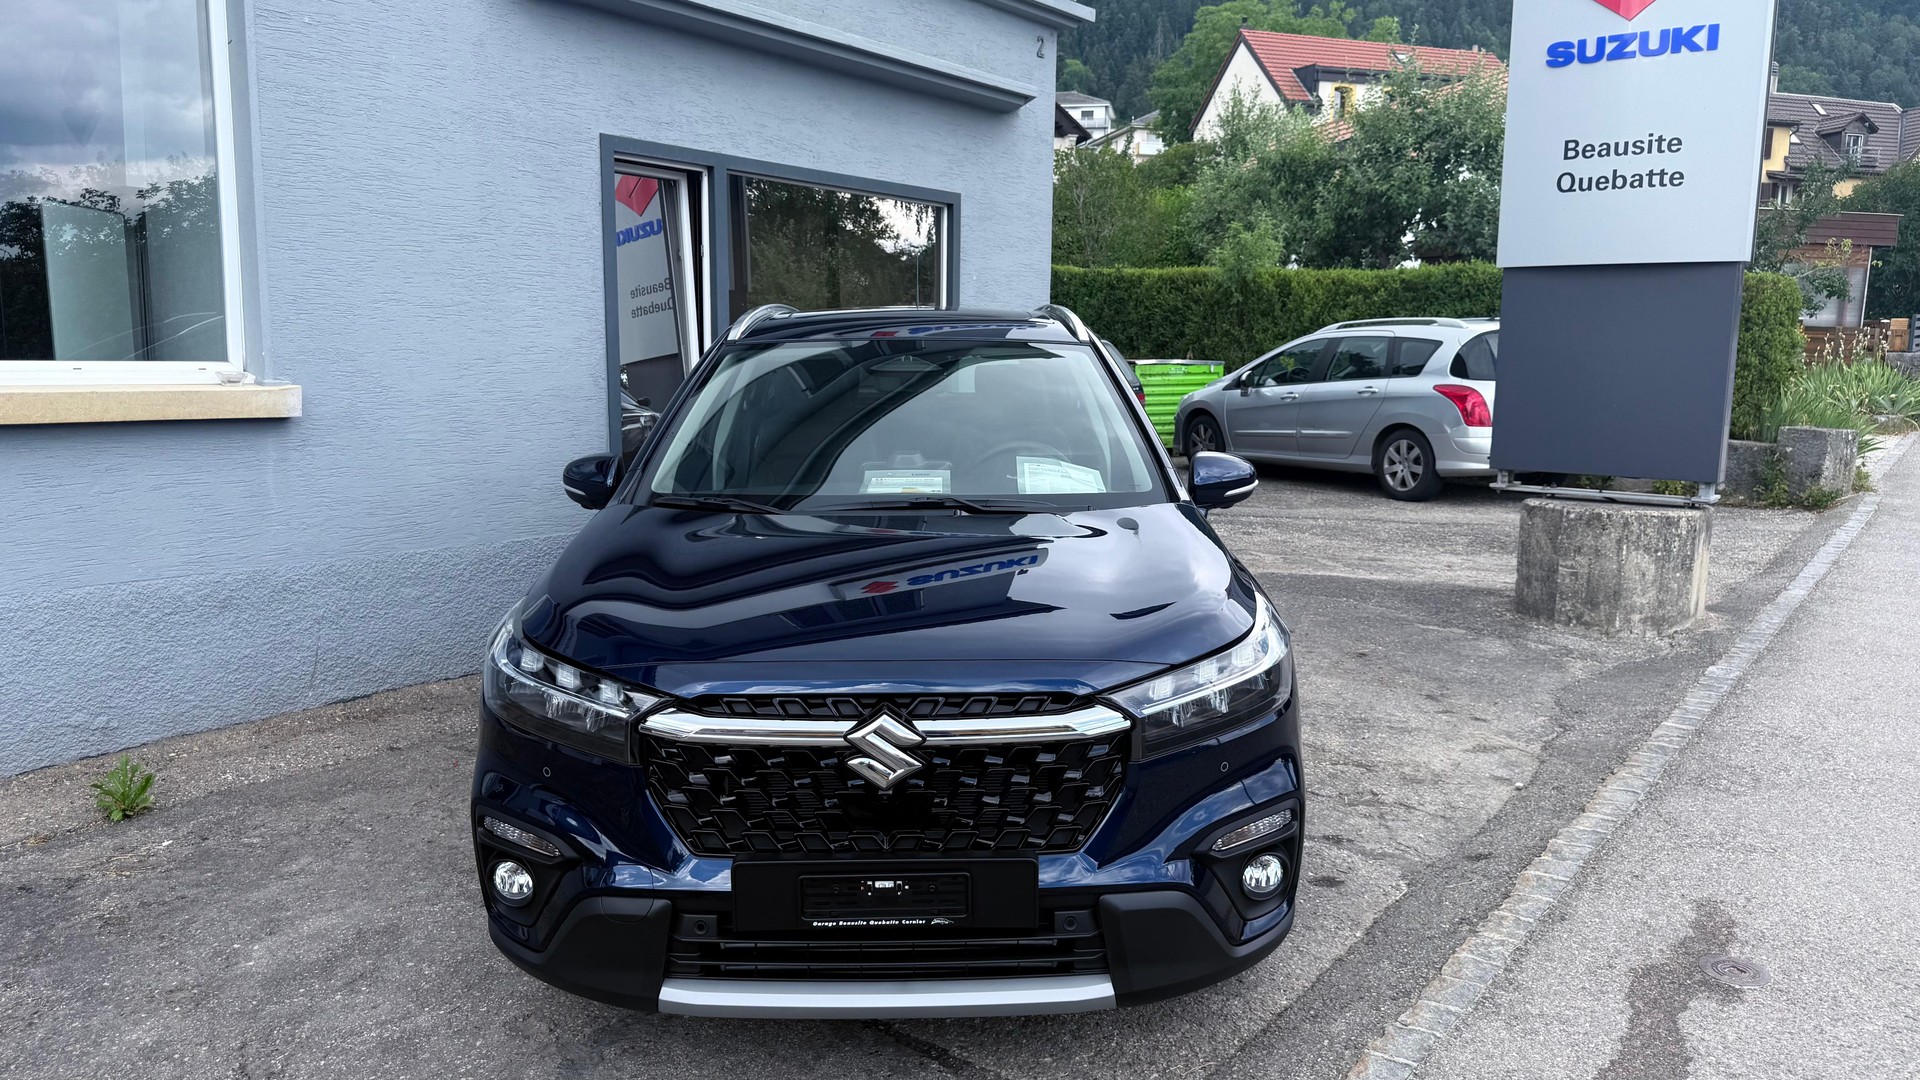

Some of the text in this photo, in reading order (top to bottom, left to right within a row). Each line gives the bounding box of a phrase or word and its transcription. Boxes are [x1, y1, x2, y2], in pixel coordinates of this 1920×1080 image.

[1037, 36, 1045, 59] 2
[1546, 23, 1720, 68] SUZUKI
[1563, 132, 1683, 161] Beausite
[1556, 167, 1685, 194] Quebatte
